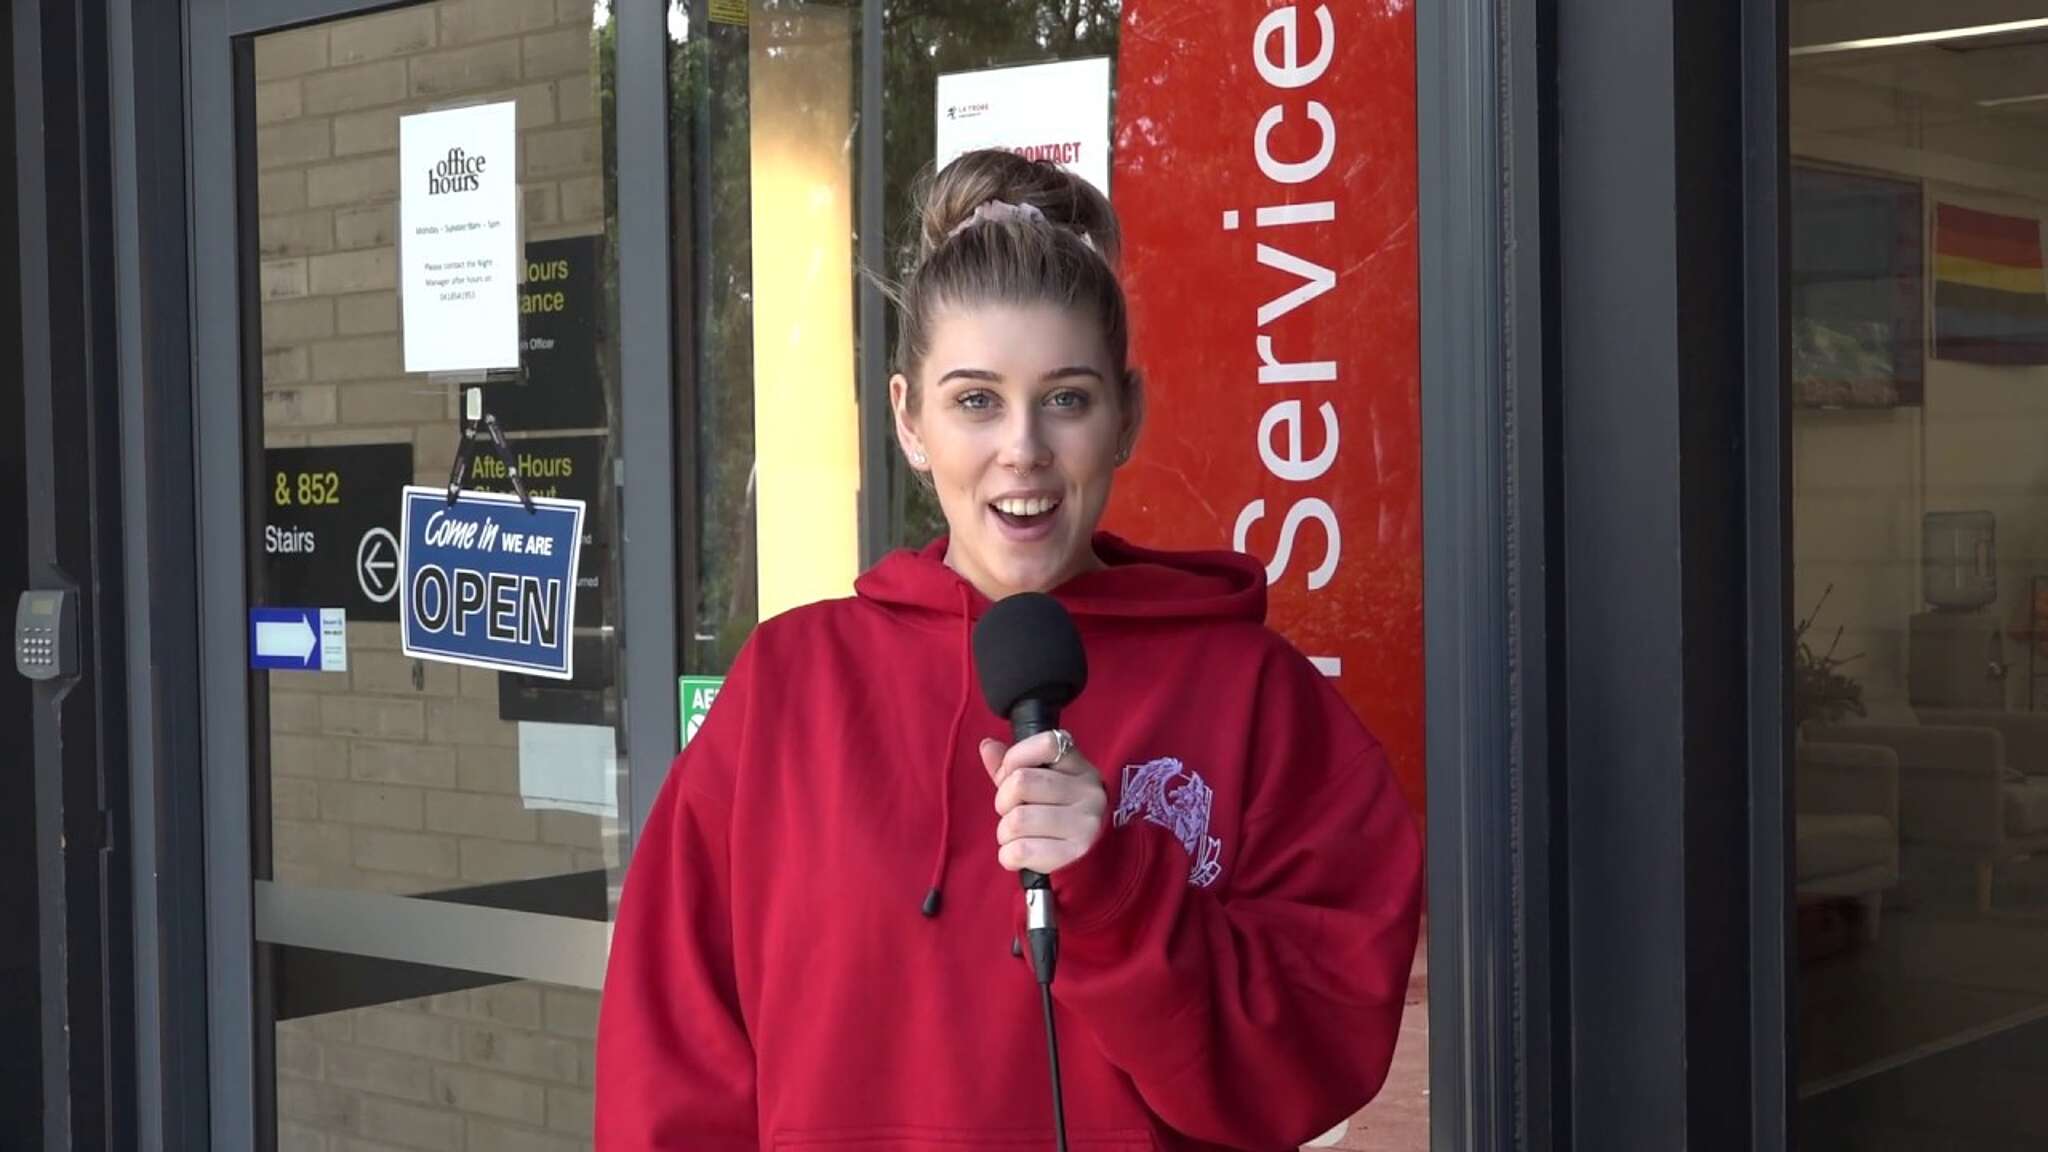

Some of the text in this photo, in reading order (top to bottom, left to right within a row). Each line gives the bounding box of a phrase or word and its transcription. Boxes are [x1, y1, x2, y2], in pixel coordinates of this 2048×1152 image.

[436, 146, 486, 177] office
[428, 168, 479, 196] hours
[1223, 4, 1341, 590] Service
[472, 453, 572, 479] Afte Hours
[275, 472, 340, 505] & 852
[265, 525, 316, 553] Stairs
[425, 510, 553, 556] Come in WE ARE
[413, 564, 560, 648] OPEN
[692, 687, 720, 709] AE
